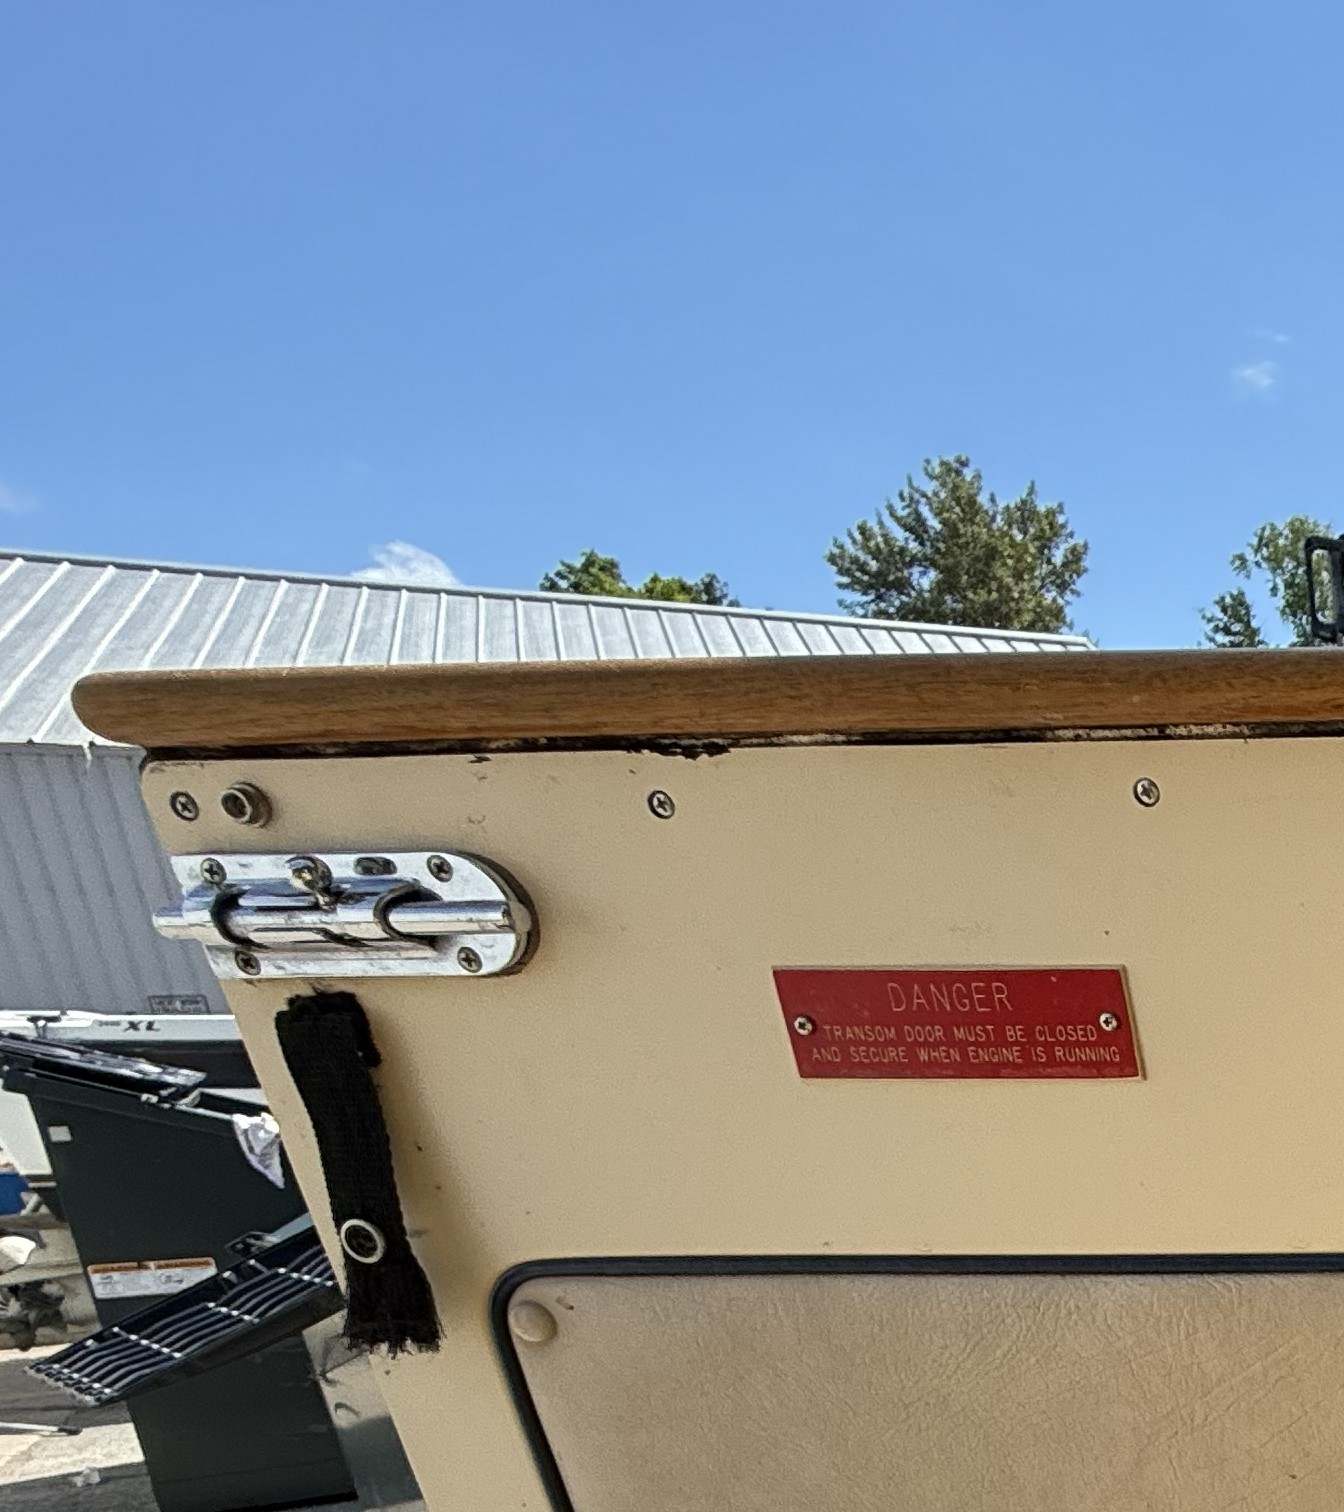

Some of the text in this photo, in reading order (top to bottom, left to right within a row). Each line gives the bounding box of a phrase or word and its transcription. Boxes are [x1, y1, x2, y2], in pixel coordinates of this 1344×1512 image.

[887, 982, 1013, 1012] DANGER
[822, 1024, 1098, 1042] TRANSOM DOOR MUST BE CLOSED
[812, 1046, 1120, 1063] AND SECURE WHEN ENGINE IS RUNNING
